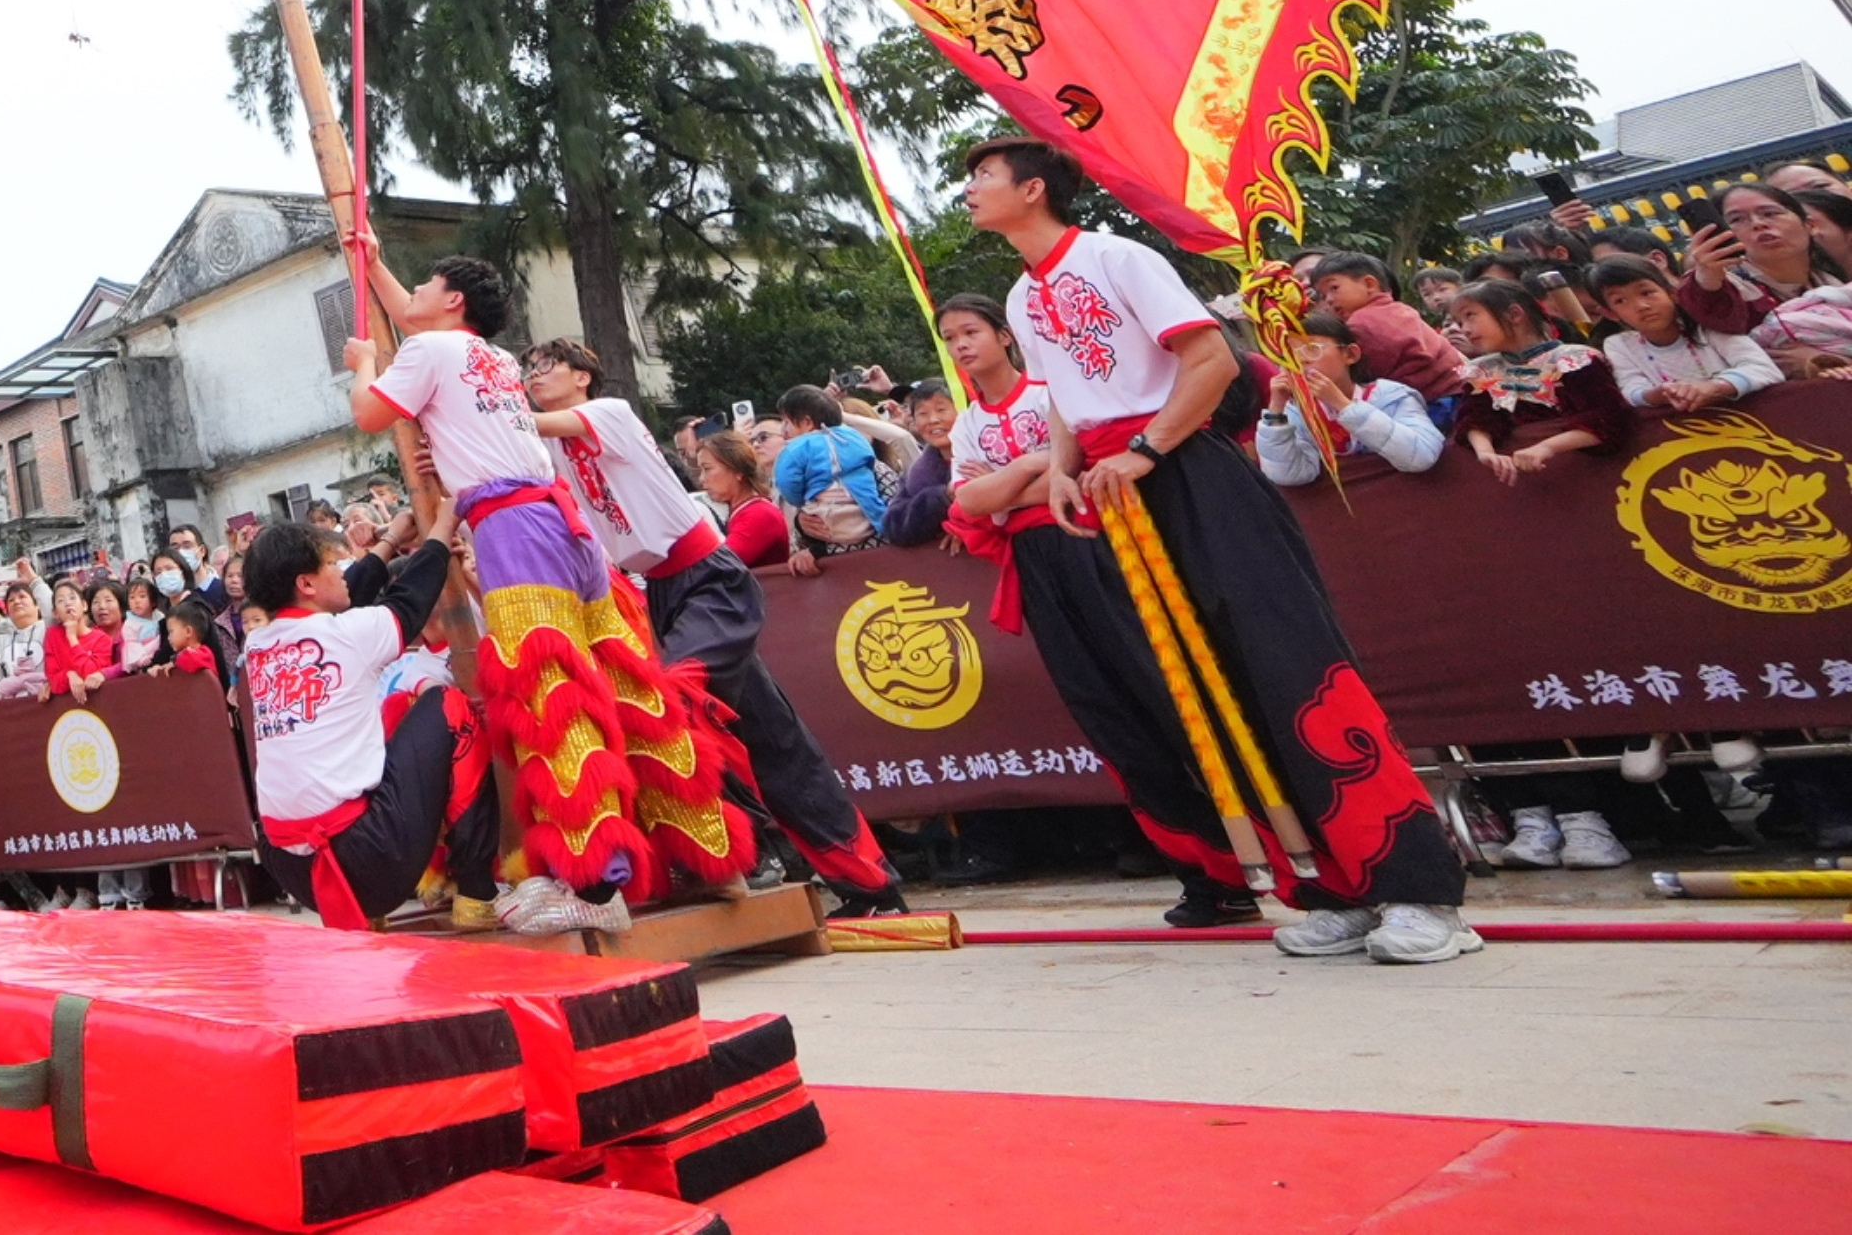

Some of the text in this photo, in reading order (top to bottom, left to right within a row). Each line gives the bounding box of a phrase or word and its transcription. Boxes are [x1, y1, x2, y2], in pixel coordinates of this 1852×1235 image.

[834, 746, 1104, 792] 高新区龙狮运动协
